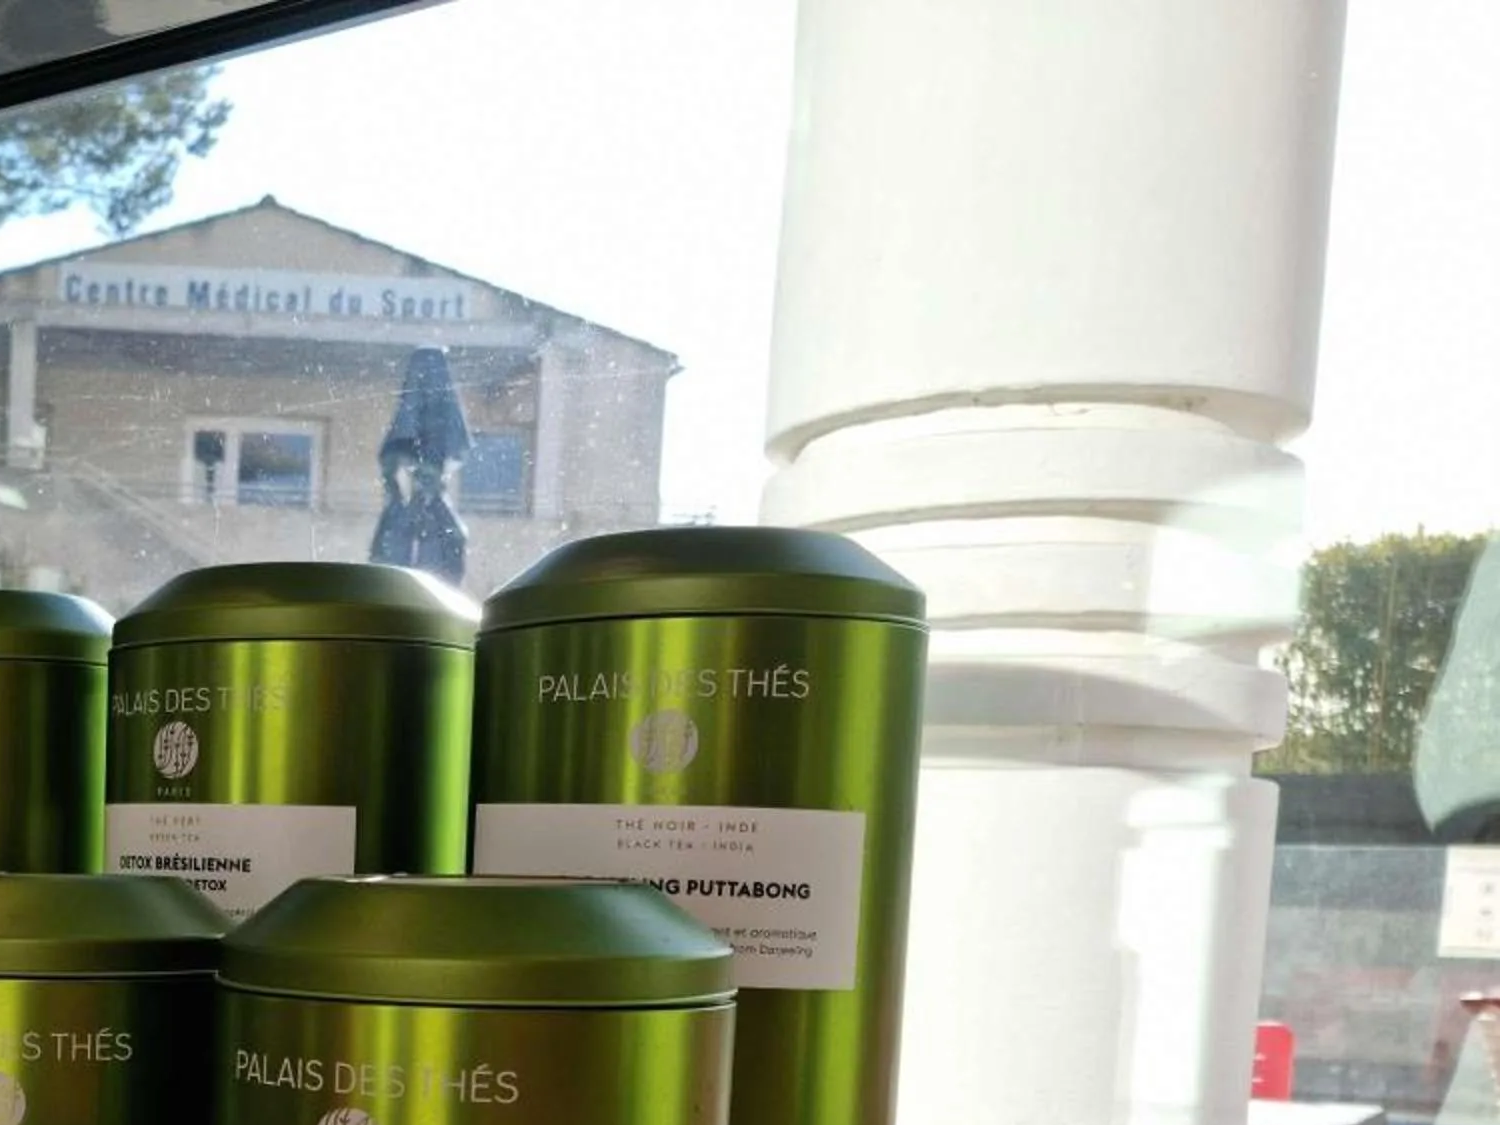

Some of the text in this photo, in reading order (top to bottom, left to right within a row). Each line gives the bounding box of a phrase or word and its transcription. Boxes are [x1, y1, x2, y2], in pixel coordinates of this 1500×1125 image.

[65, 273, 465, 321] Centre Médical du Sport
[538, 671, 639, 703] PALAIS
[726, 663, 811, 699] THÉS
[164, 687, 212, 713] DES
[653, 820, 696, 832] NOIR
[717, 821, 760, 834] INDE
[616, 837, 755, 853] BLACK TEA INDIA
[119, 852, 252, 873] DETOX BRÉSILIENNE
[687, 879, 812, 900] PUTTABONG
[51, 1027, 134, 1062] THÉS
[235, 1049, 325, 1092] PALAIS
[335, 1061, 406, 1099] DES
